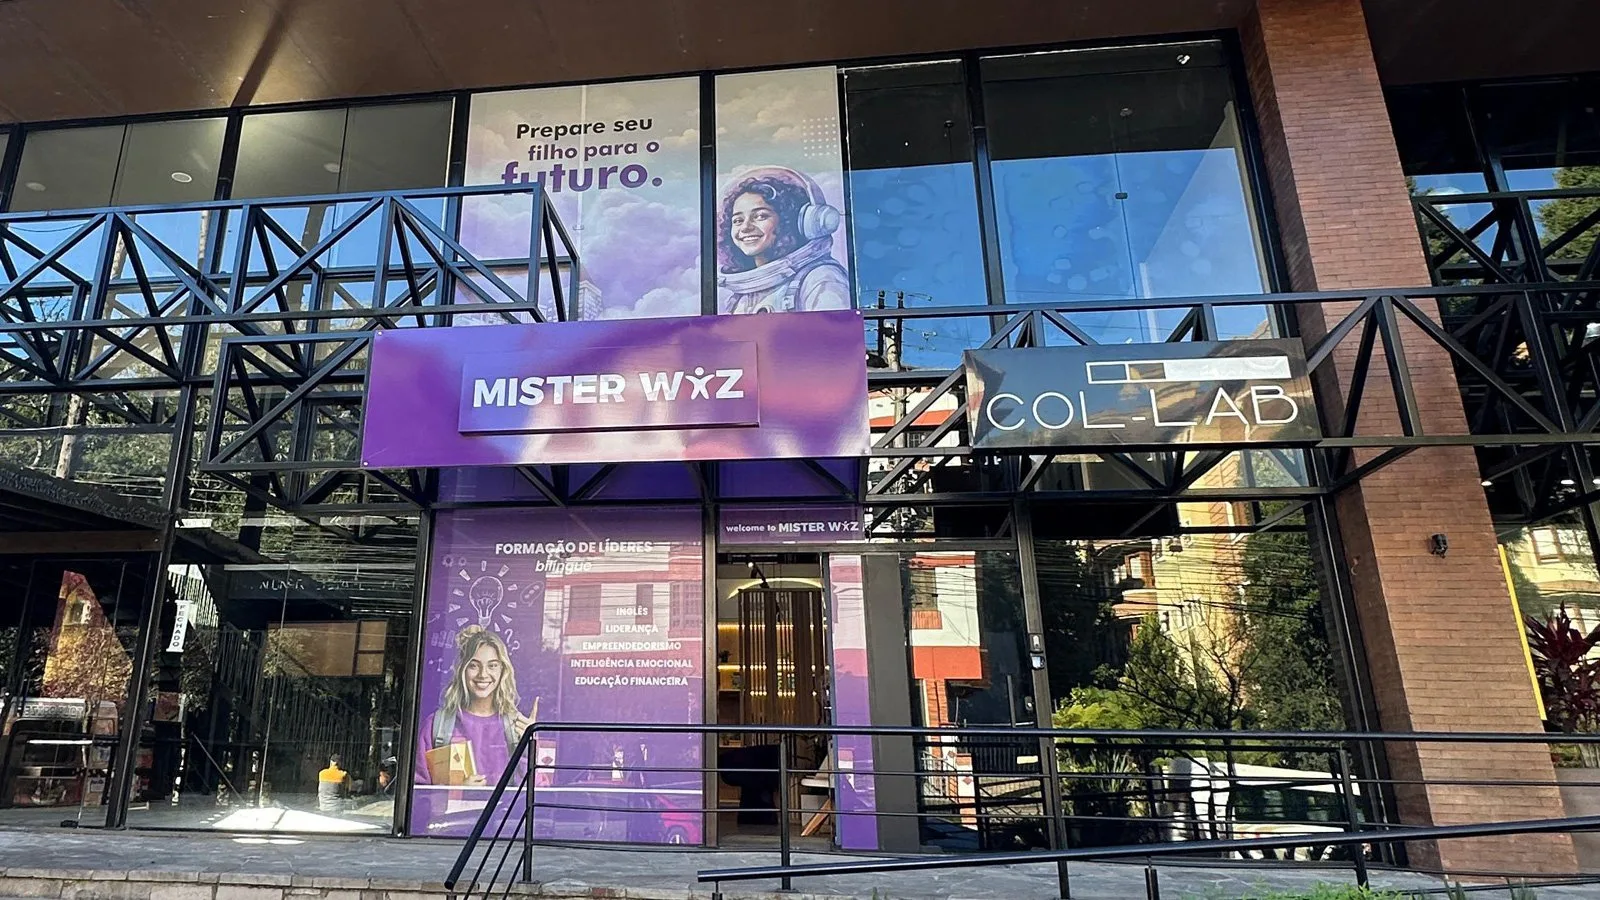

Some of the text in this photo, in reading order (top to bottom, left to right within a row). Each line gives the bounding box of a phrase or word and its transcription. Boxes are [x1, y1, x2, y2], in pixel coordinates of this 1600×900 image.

[516, 118, 653, 141] Prepare seu
[528, 141, 660, 162] filho para o
[501, 161, 663, 193] futuro.
[473, 374, 626, 408] MISTER
[986, 385, 1299, 431] COL-LAB
[725, 523, 765, 533] welcome
[767, 524, 777, 532] to
[778, 522, 826, 533] MISTER
[495, 538, 653, 557] FORMAÇÃO DE LÍDERES
[616, 605, 648, 616] INGLÊS
[172, 604, 187, 647] FECHADO
[605, 624, 659, 635] LIDERANÇA
[582, 641, 682, 651] EMPREENDEDORISMO
[570, 657, 693, 668] INTELIGÊNCIA EMOCIONAL
[574, 675, 689, 688] EDUCAÇÃO FINANCEIRA
